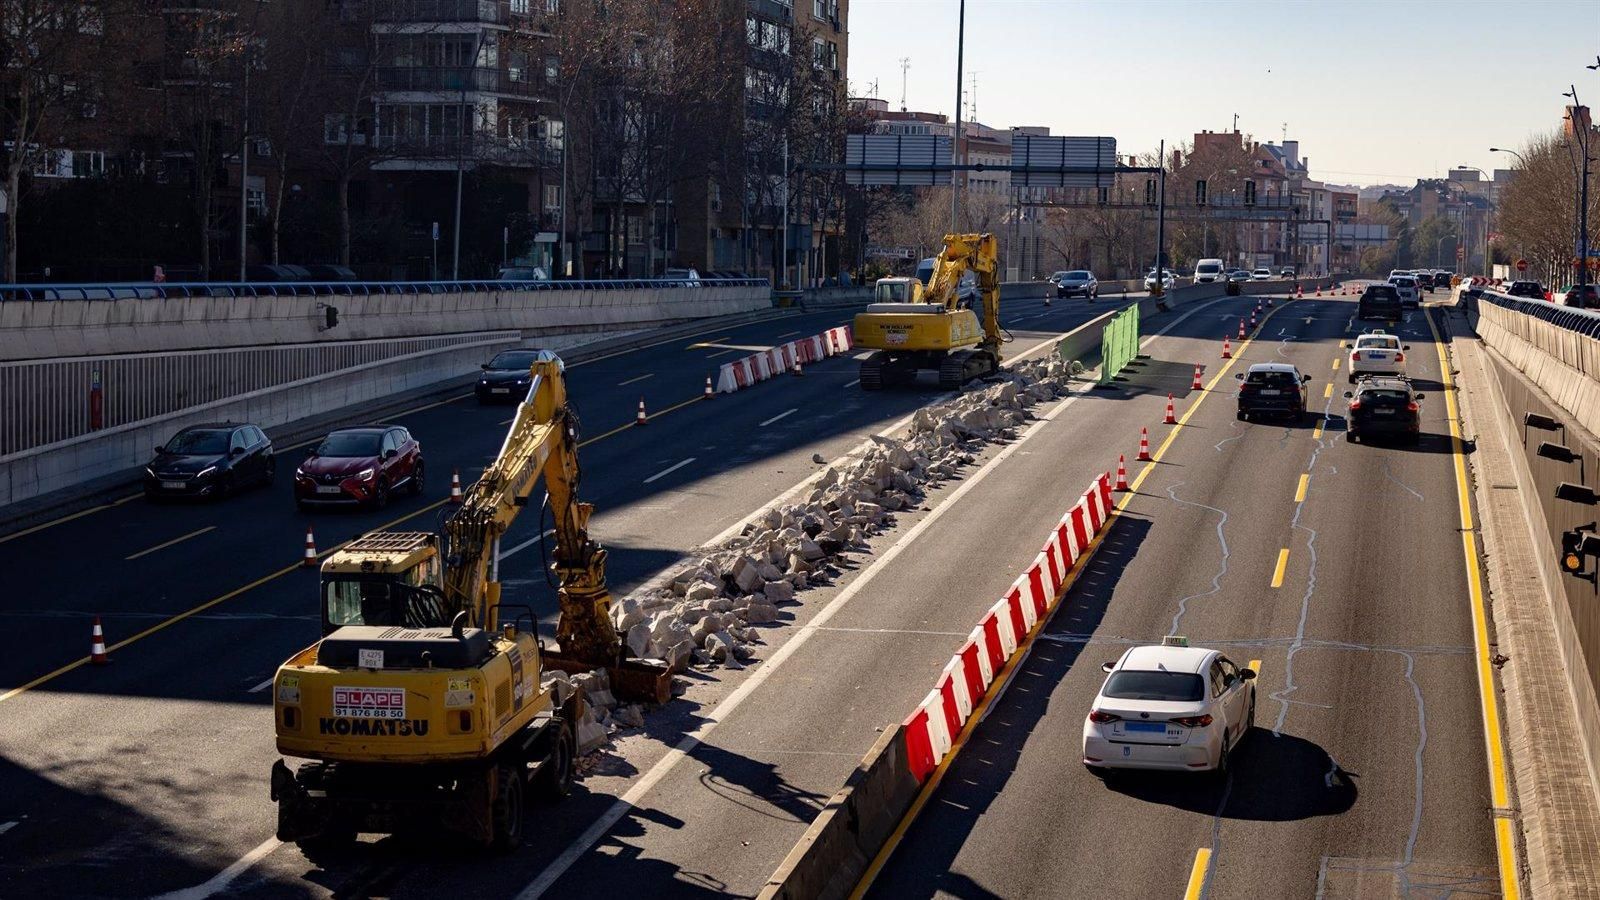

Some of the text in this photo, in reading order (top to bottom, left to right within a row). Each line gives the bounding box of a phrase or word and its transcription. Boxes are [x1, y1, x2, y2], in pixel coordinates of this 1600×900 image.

[335, 692, 403, 706] BLAPE
[351, 709, 371, 717] 876
[319, 719, 428, 736] KOMATSU
